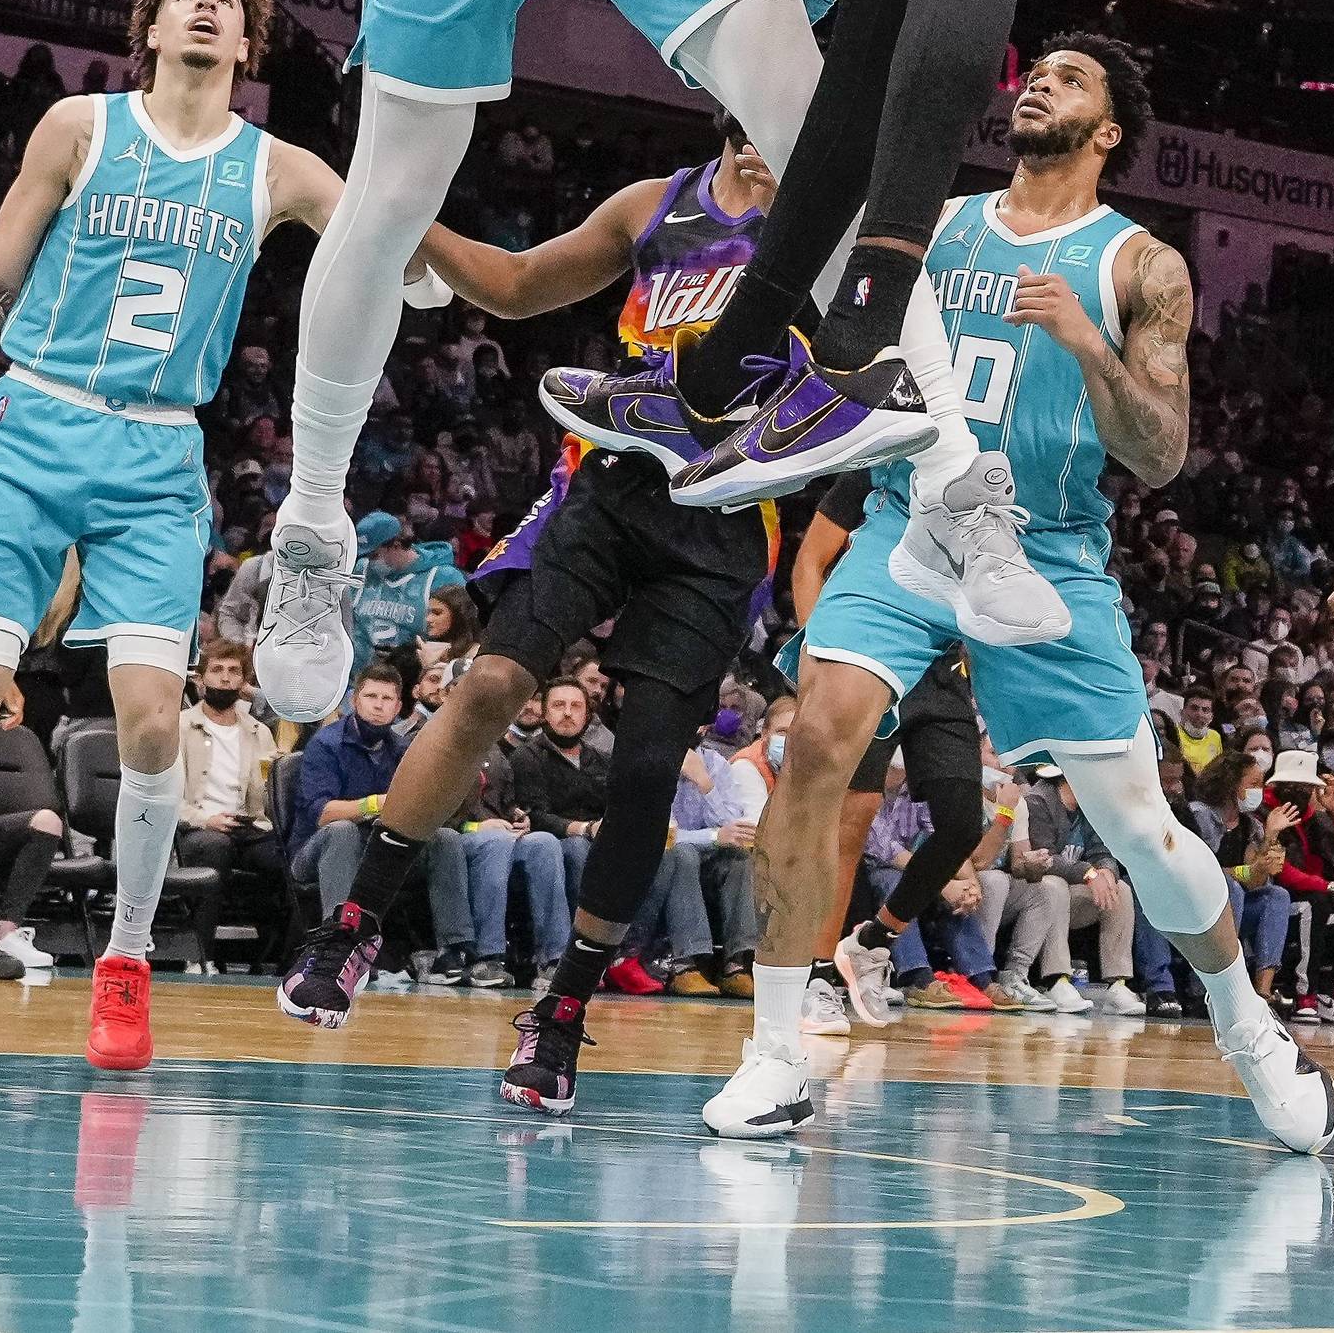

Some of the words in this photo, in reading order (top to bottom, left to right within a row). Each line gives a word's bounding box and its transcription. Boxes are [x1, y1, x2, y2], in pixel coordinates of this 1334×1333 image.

[88, 194, 244, 265] HORNETS
[106, 257, 187, 353] 2
[679, 273, 710, 287] THE
[953, 333, 1018, 426] 0
